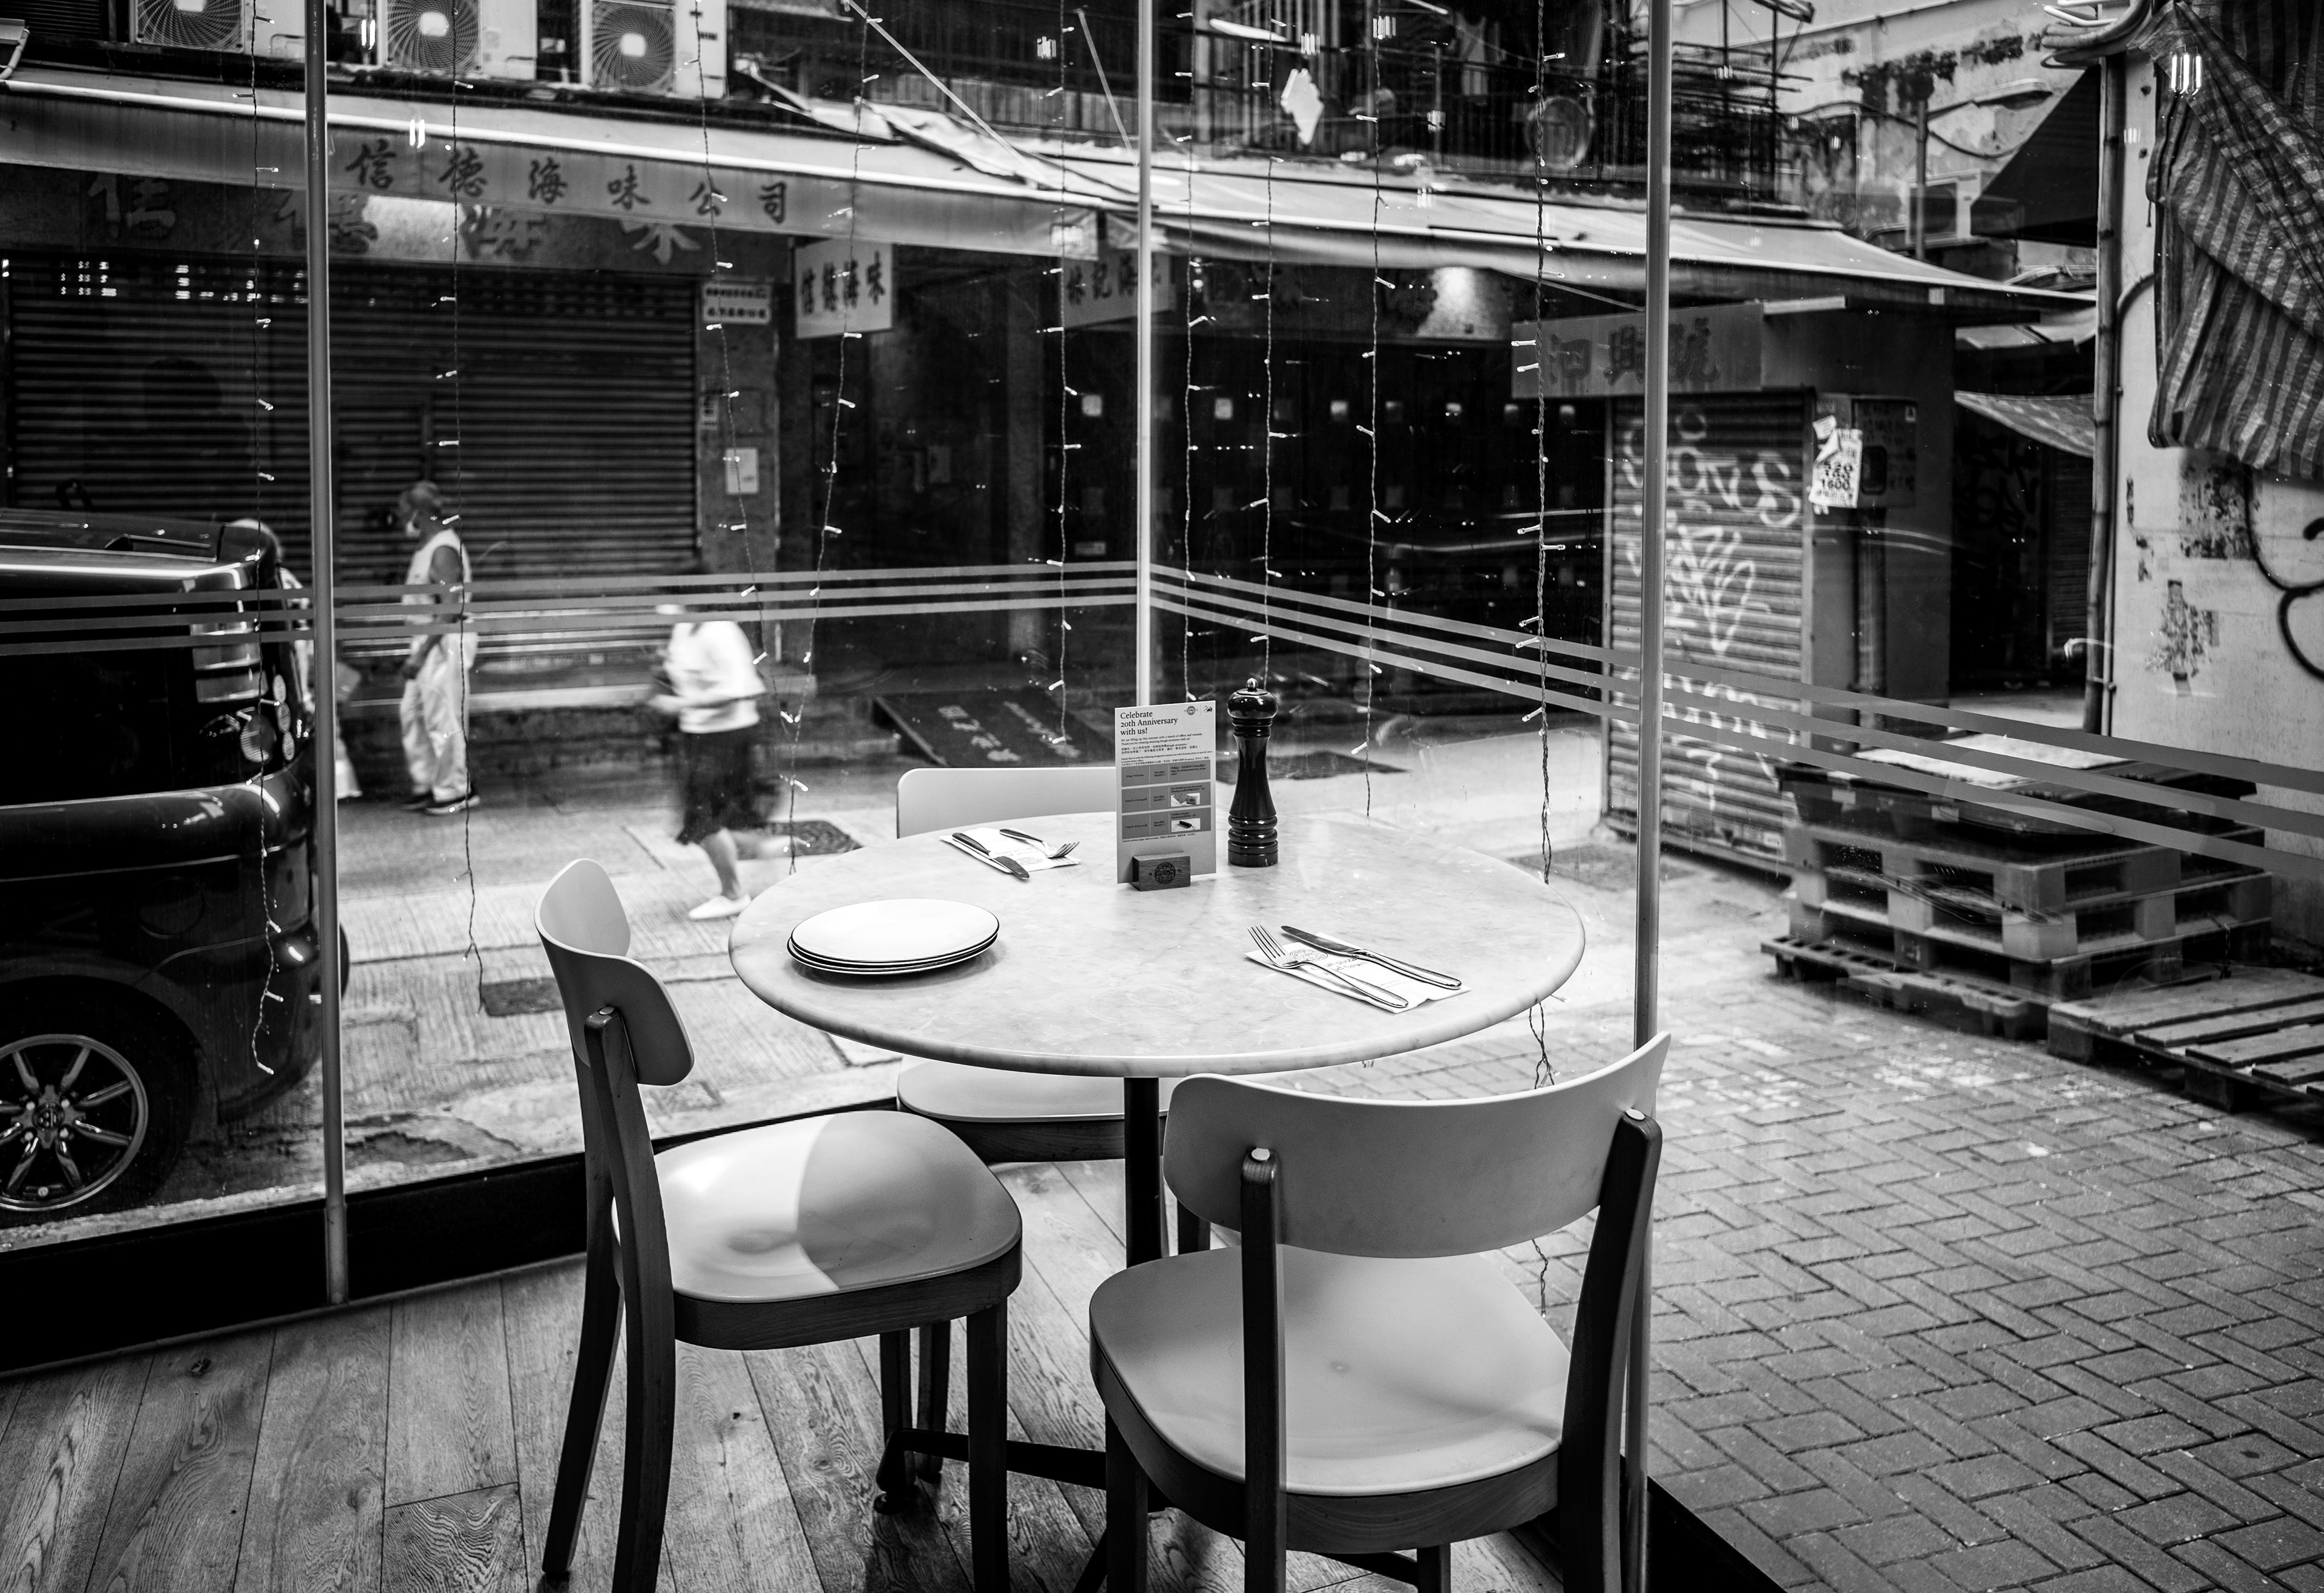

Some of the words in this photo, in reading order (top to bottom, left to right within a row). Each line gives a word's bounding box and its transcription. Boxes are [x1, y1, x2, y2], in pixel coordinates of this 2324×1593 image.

[346, 138, 786, 224] 信德海味公司
[1137, 718, 1178, 726] Anniversary
